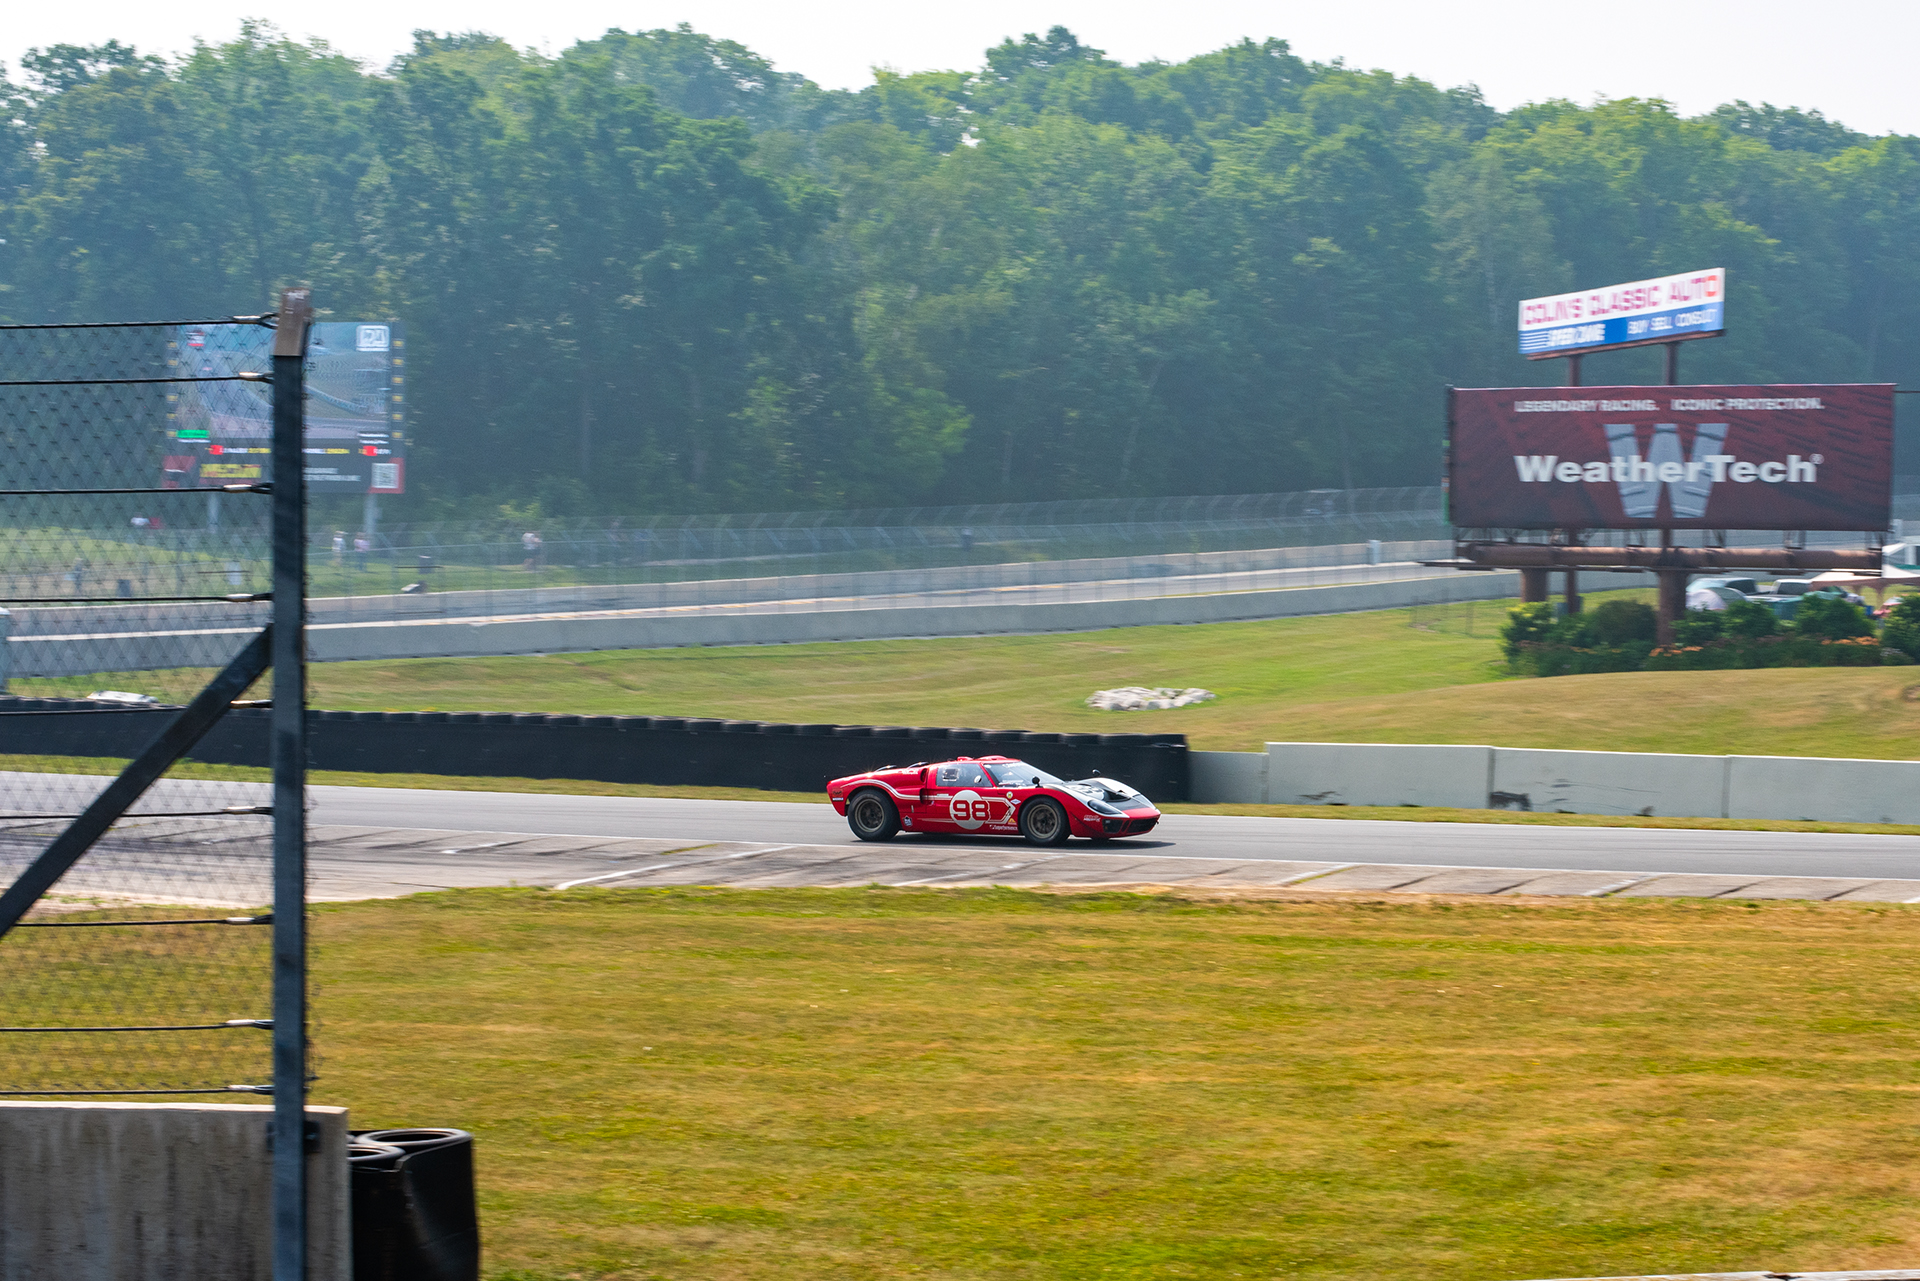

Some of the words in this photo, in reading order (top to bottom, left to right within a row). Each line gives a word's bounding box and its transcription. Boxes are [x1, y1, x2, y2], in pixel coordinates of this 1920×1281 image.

[1588, 285, 1661, 316] CLASSIC
[1667, 274, 1720, 302] AUTO
[1514, 400, 1596, 413] LEGENDARY
[1599, 399, 1660, 412] RACING.
[1670, 398, 1726, 411] ICONIC
[1727, 397, 1825, 411] PROTECTION.
[953, 798, 991, 822] 98
